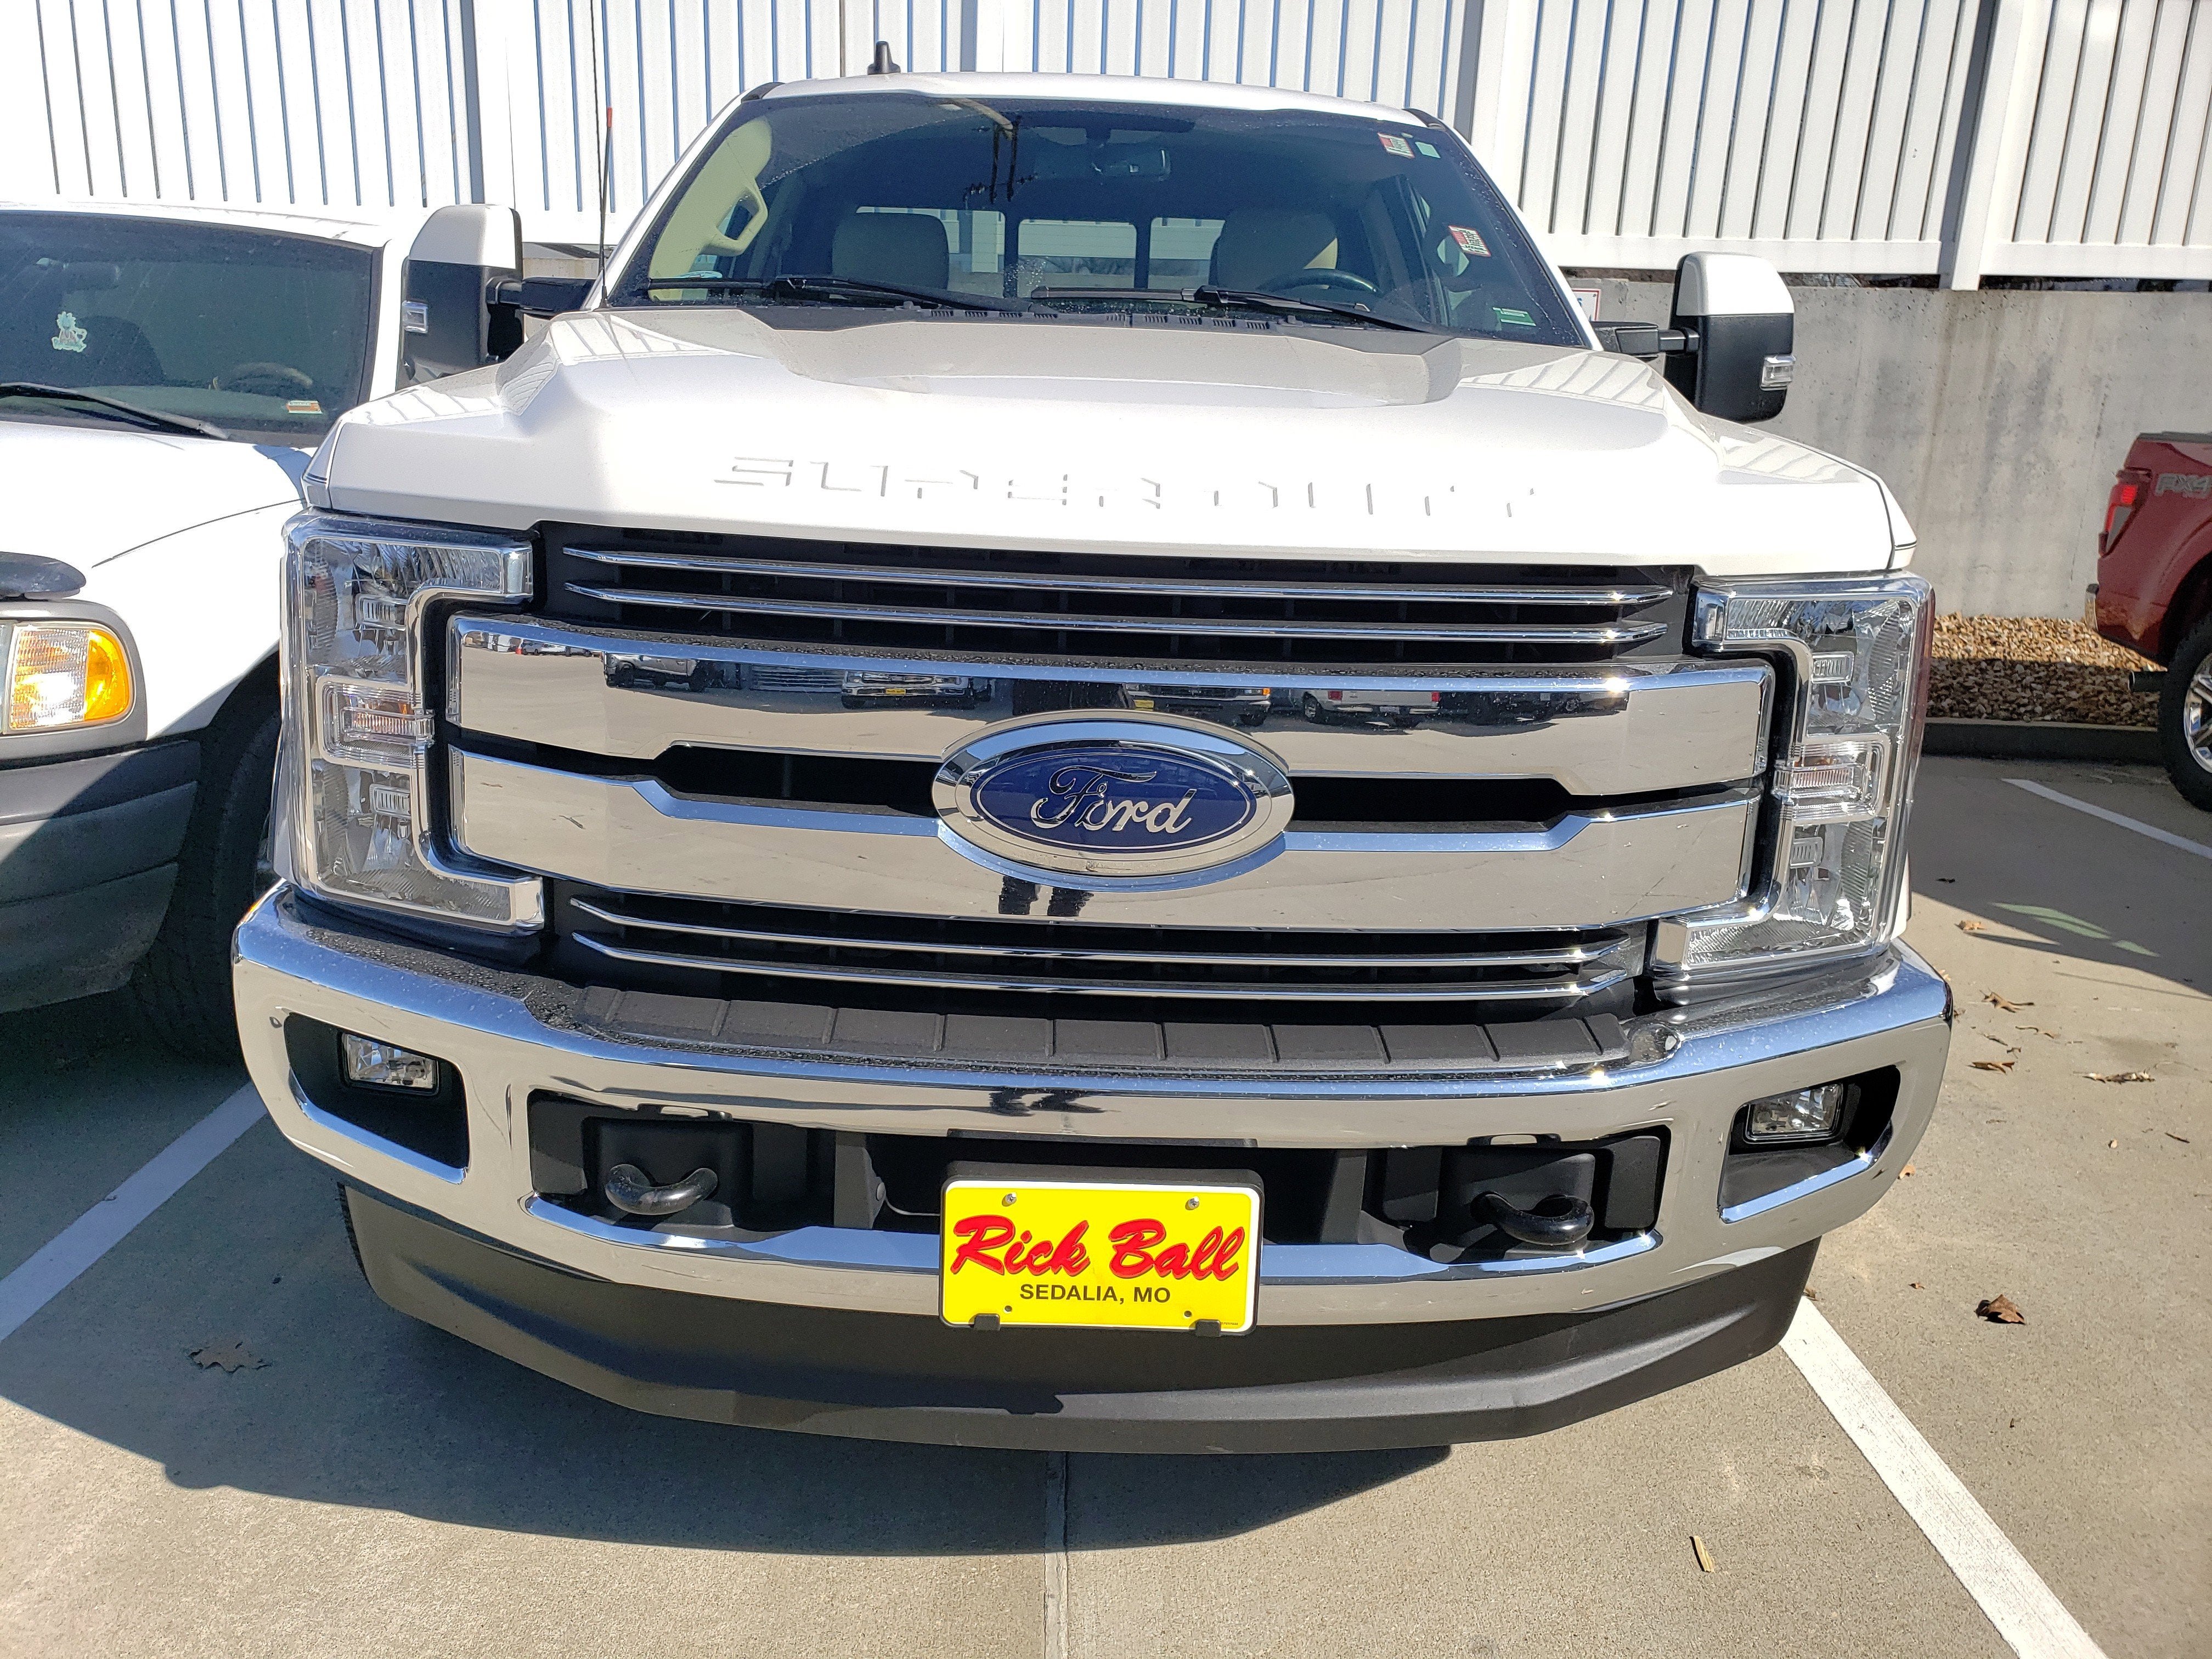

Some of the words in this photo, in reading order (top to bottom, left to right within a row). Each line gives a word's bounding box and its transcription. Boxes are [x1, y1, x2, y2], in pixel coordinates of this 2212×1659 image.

[2154, 472, 2212, 499] FX4
[1030, 765, 1198, 834] Ford
[950, 1214, 1091, 1277] Rick
[1108, 1218, 1245, 1282] Ball
[1019, 1284, 1125, 1305] SEDALIA,
[1133, 1286, 1171, 1304] MO
